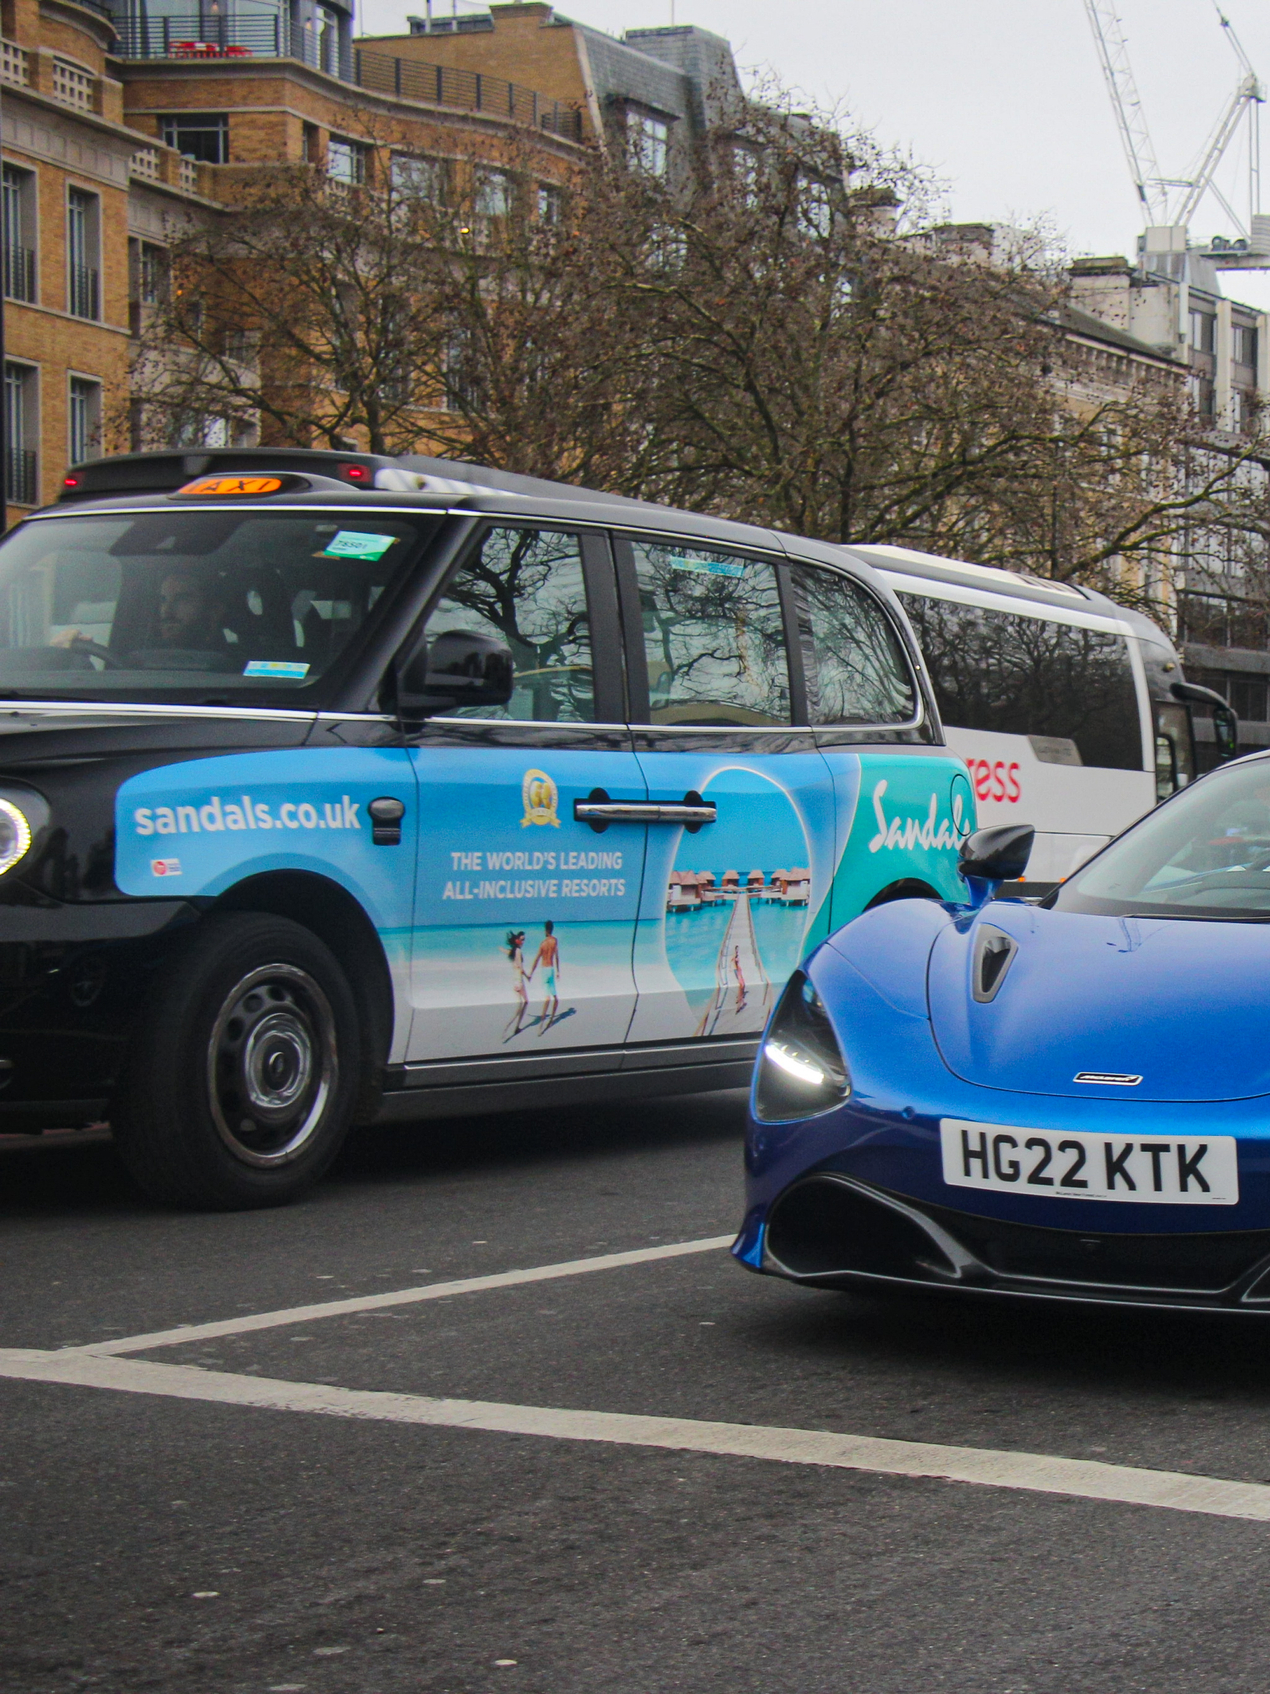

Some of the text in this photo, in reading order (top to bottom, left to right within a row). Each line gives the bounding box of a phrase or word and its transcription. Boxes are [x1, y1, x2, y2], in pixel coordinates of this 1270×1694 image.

[134, 795, 361, 836] sandals.co.uk
[451, 851, 623, 870] THE WORLD'S LEADING
[442, 879, 626, 900] ALL-INCLUSIVE RESORTS
[961, 1130, 1211, 1192] HG22 KTK
